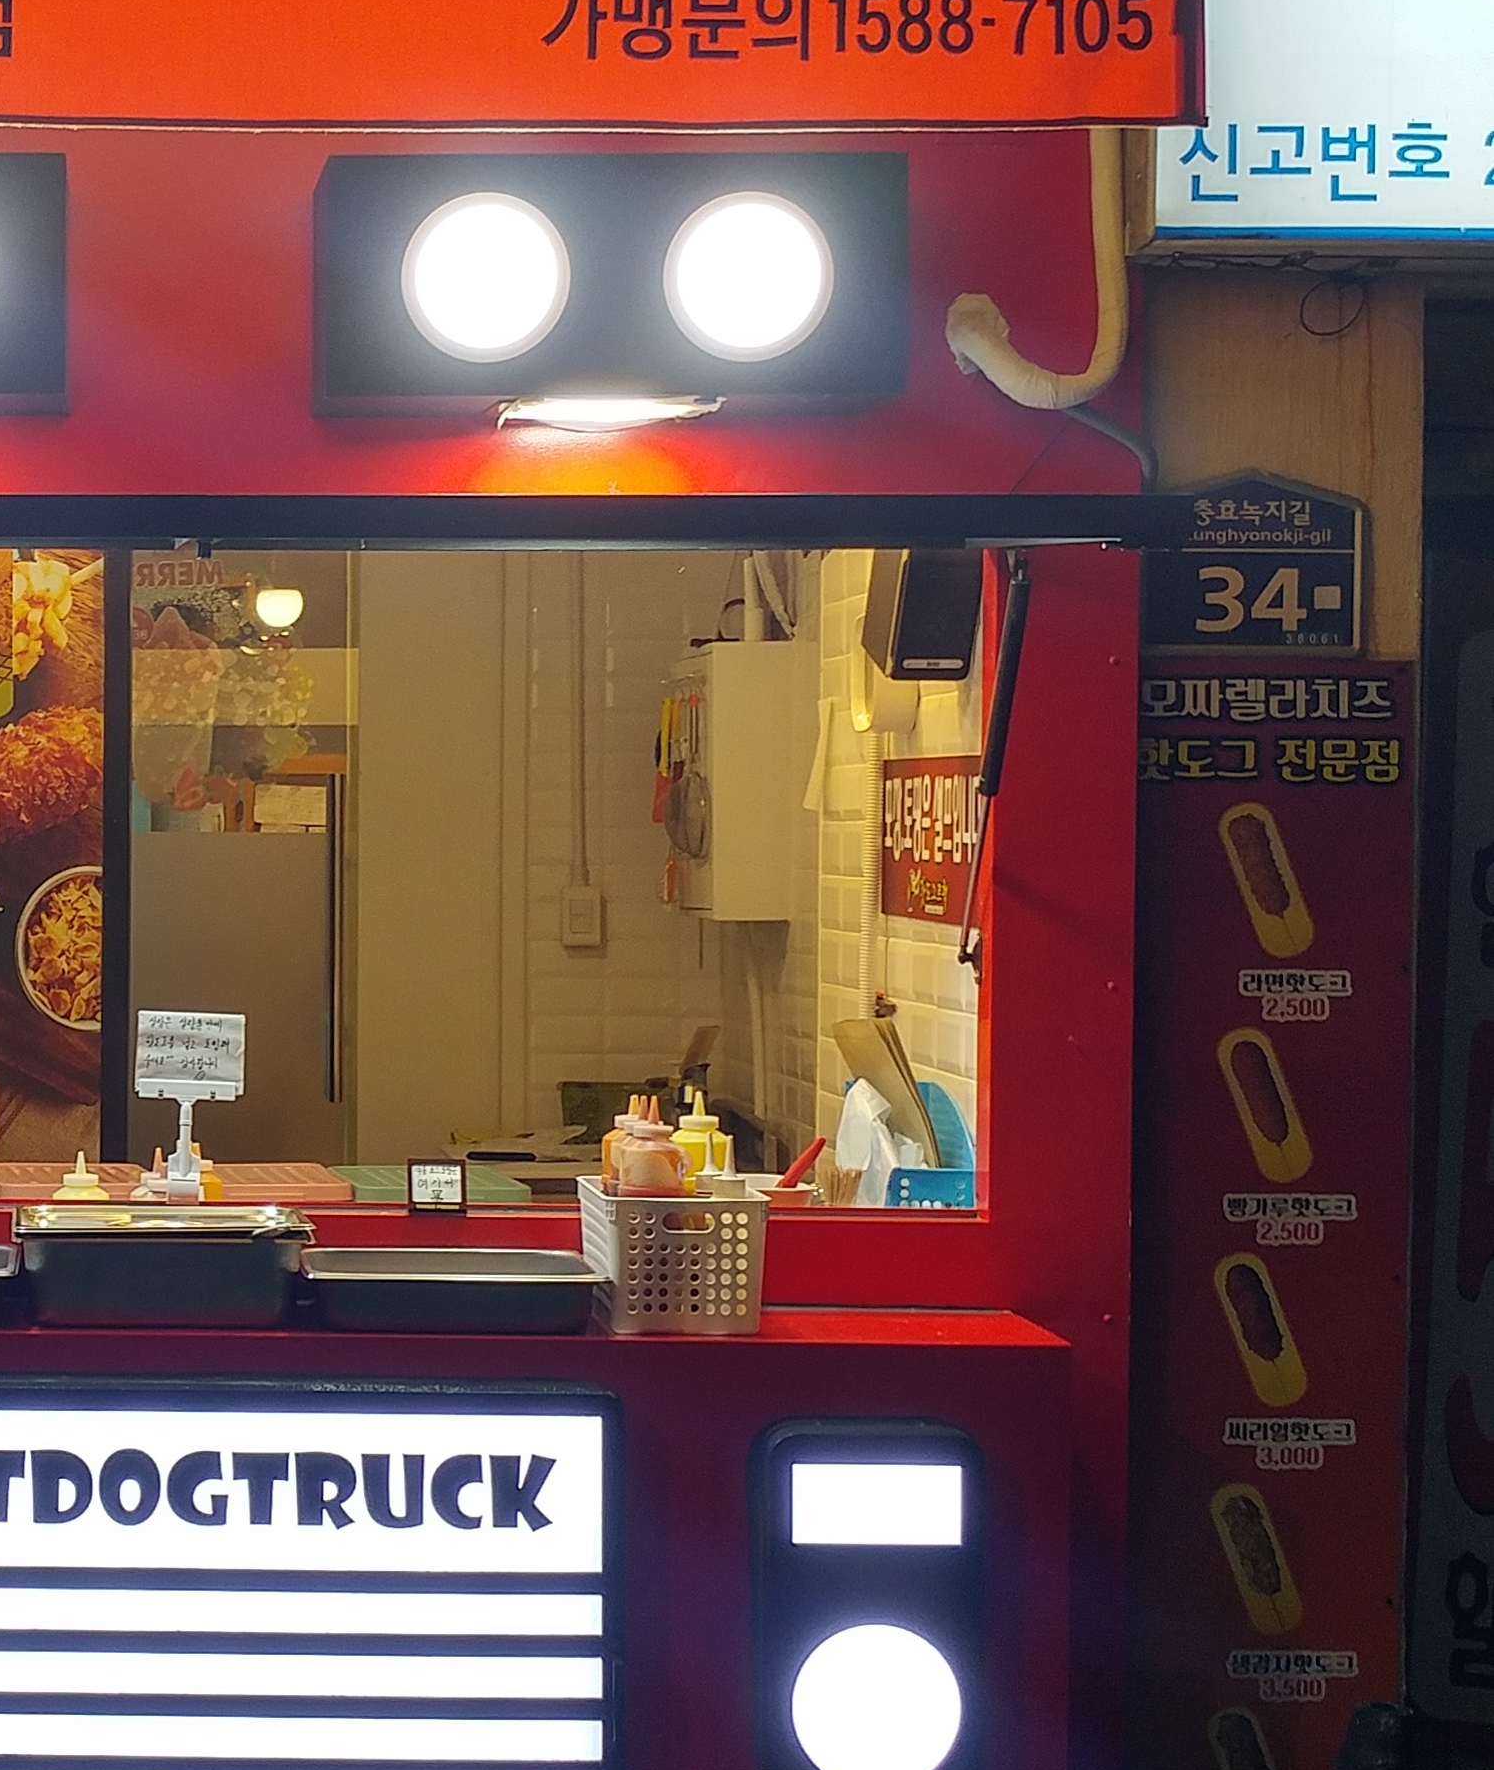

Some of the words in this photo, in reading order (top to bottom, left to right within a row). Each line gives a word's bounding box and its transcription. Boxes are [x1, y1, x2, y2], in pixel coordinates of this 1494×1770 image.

[1179, 122, 1451, 202] 신고번호
[1192, 498, 1312, 527] 충효녹지길
[1194, 565, 1308, 633] 34
[1139, 678, 1393, 722] 모짜렐라치즈
[1137, 737, 1259, 781] 핫도그
[1276, 738, 1401, 783] 전문점
[1241, 973, 1350, 993] 라면핫도그
[1265, 997, 1326, 1018] 2,500
[1226, 1196, 1354, 1218] 빵가루핫도그
[1259, 1222, 1320, 1242] 2,500
